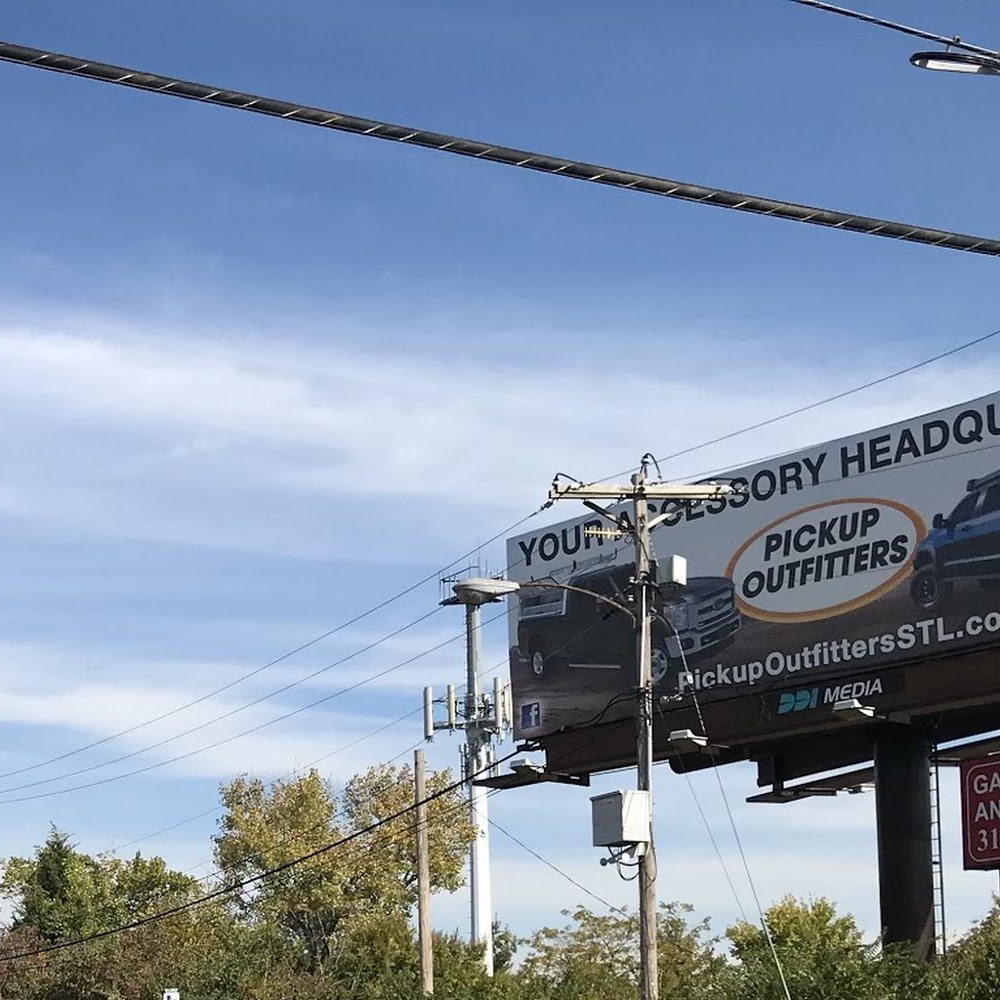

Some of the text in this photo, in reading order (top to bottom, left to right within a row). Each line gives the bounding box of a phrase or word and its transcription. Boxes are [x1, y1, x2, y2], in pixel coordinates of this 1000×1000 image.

[518, 519, 603, 566] YOUR
[763, 507, 880, 562] PICKUP
[742, 534, 909, 599] OUTFITTERS
[823, 678, 883, 704] MEDIA
[977, 828, 999, 851] 31
